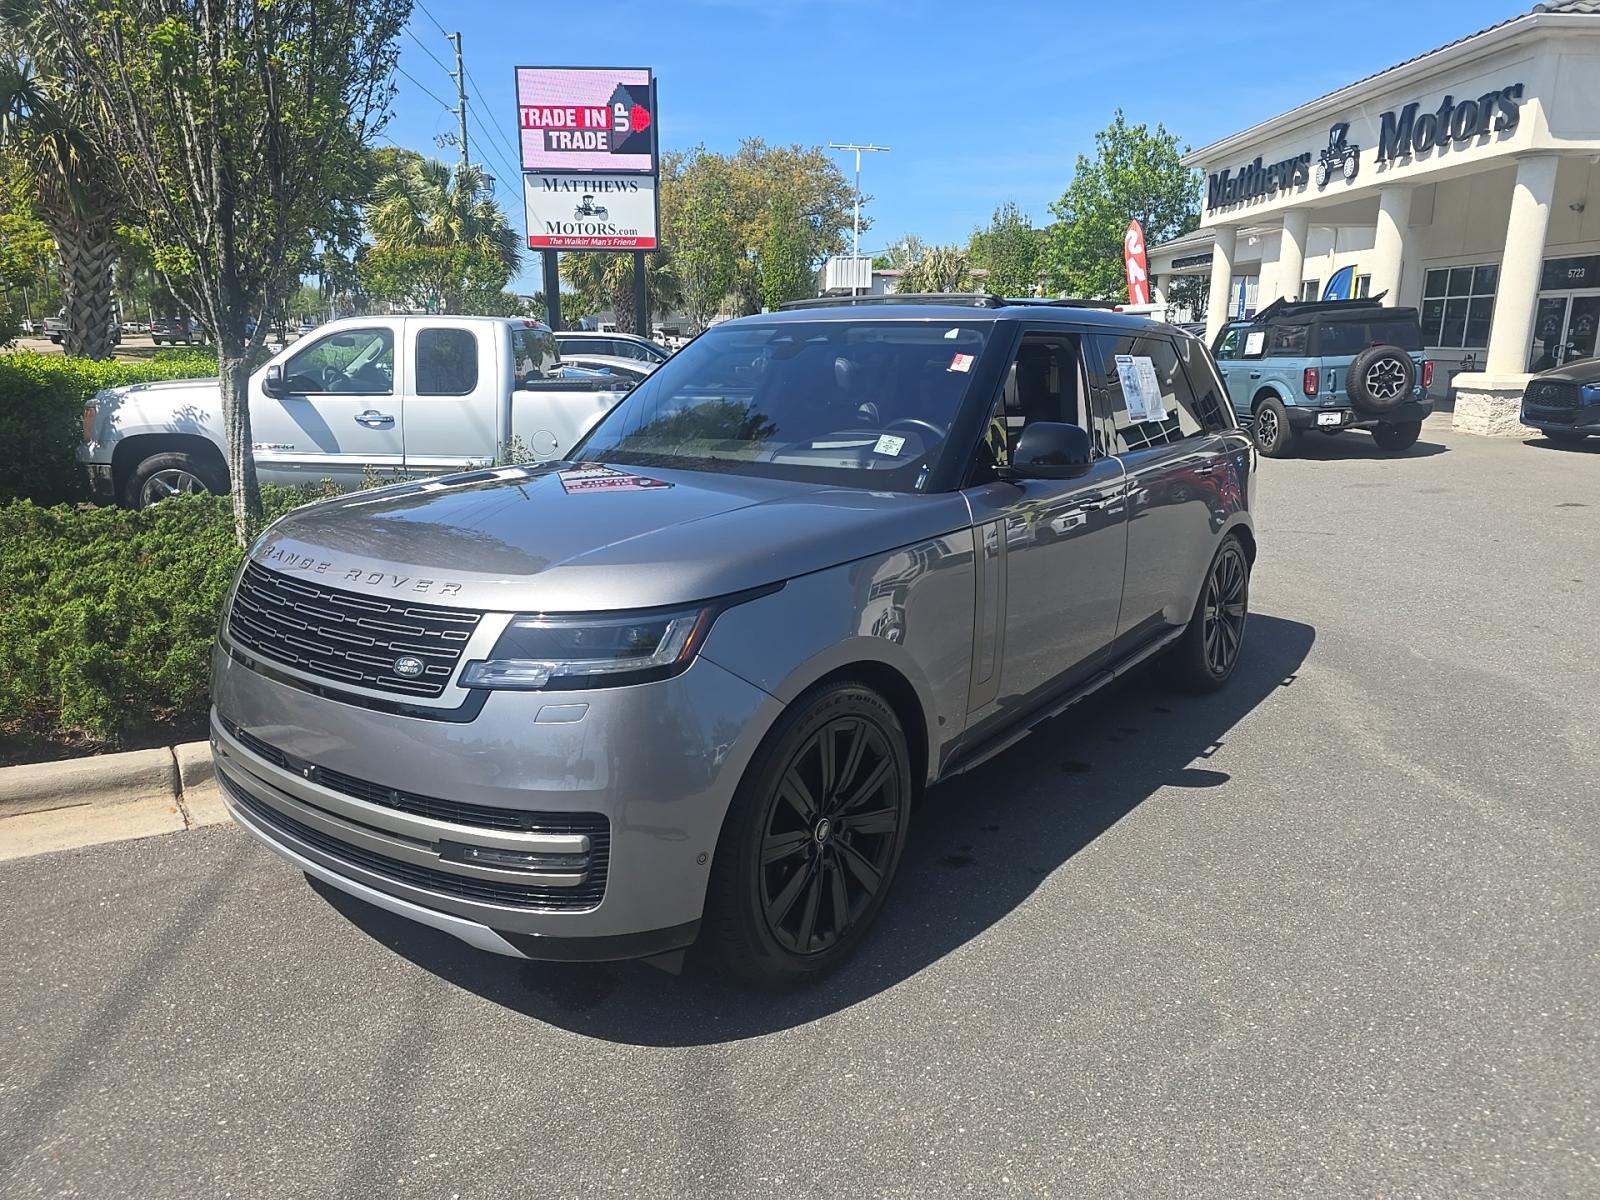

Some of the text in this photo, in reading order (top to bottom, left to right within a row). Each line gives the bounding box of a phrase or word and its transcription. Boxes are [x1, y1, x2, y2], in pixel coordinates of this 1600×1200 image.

[520, 107, 606, 128] TRADE IN
[614, 102, 630, 132] UP
[549, 131, 608, 150] TRADE
[1206, 82, 1525, 211] Matthews Motors
[542, 177, 638, 193] MATTHEWS
[591, 238, 612, 246] Man's
[612, 238, 637, 246] Friend
[1567, 268, 1586, 278] 5723
[262, 544, 464, 596] RANGE ROVER
